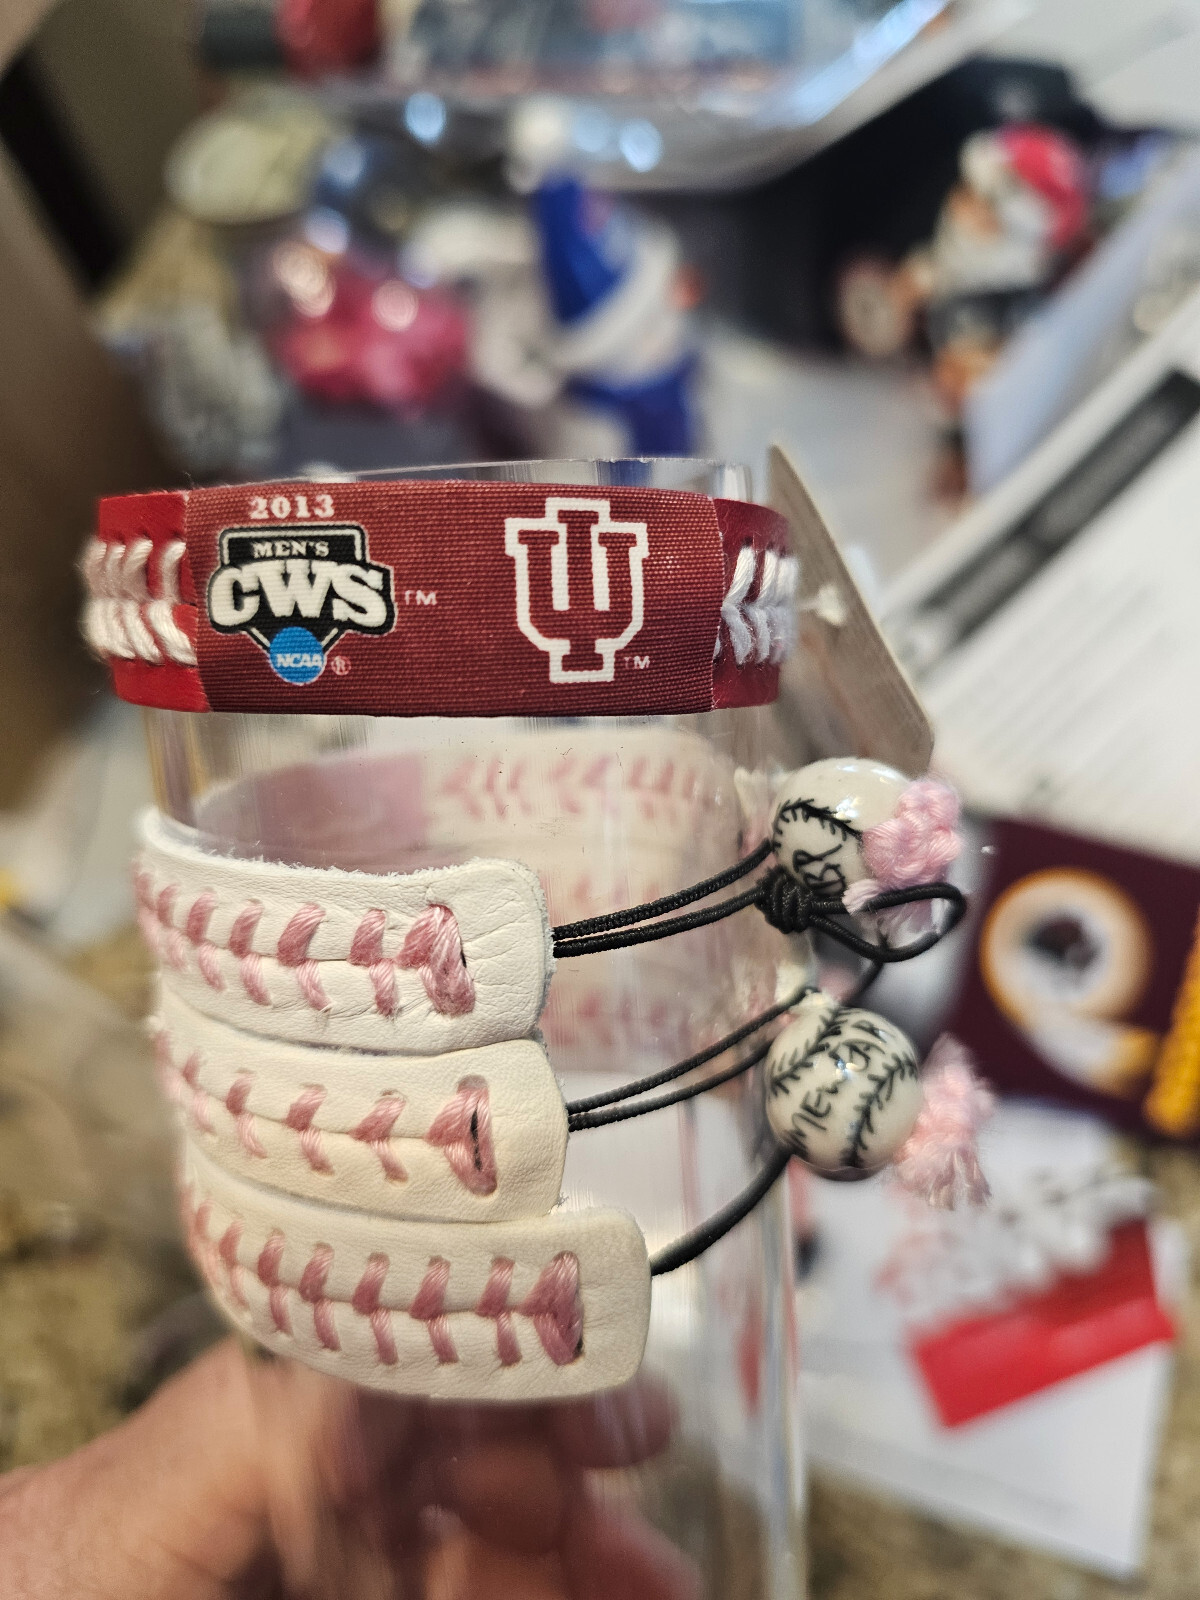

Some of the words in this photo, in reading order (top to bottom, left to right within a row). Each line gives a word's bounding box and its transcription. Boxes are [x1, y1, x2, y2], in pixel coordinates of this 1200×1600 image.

[250, 494, 335, 519] 2013
[252, 541, 330, 559] MEN'S
[210, 558, 388, 628] CWS
[276, 653, 323, 668] NCAA
